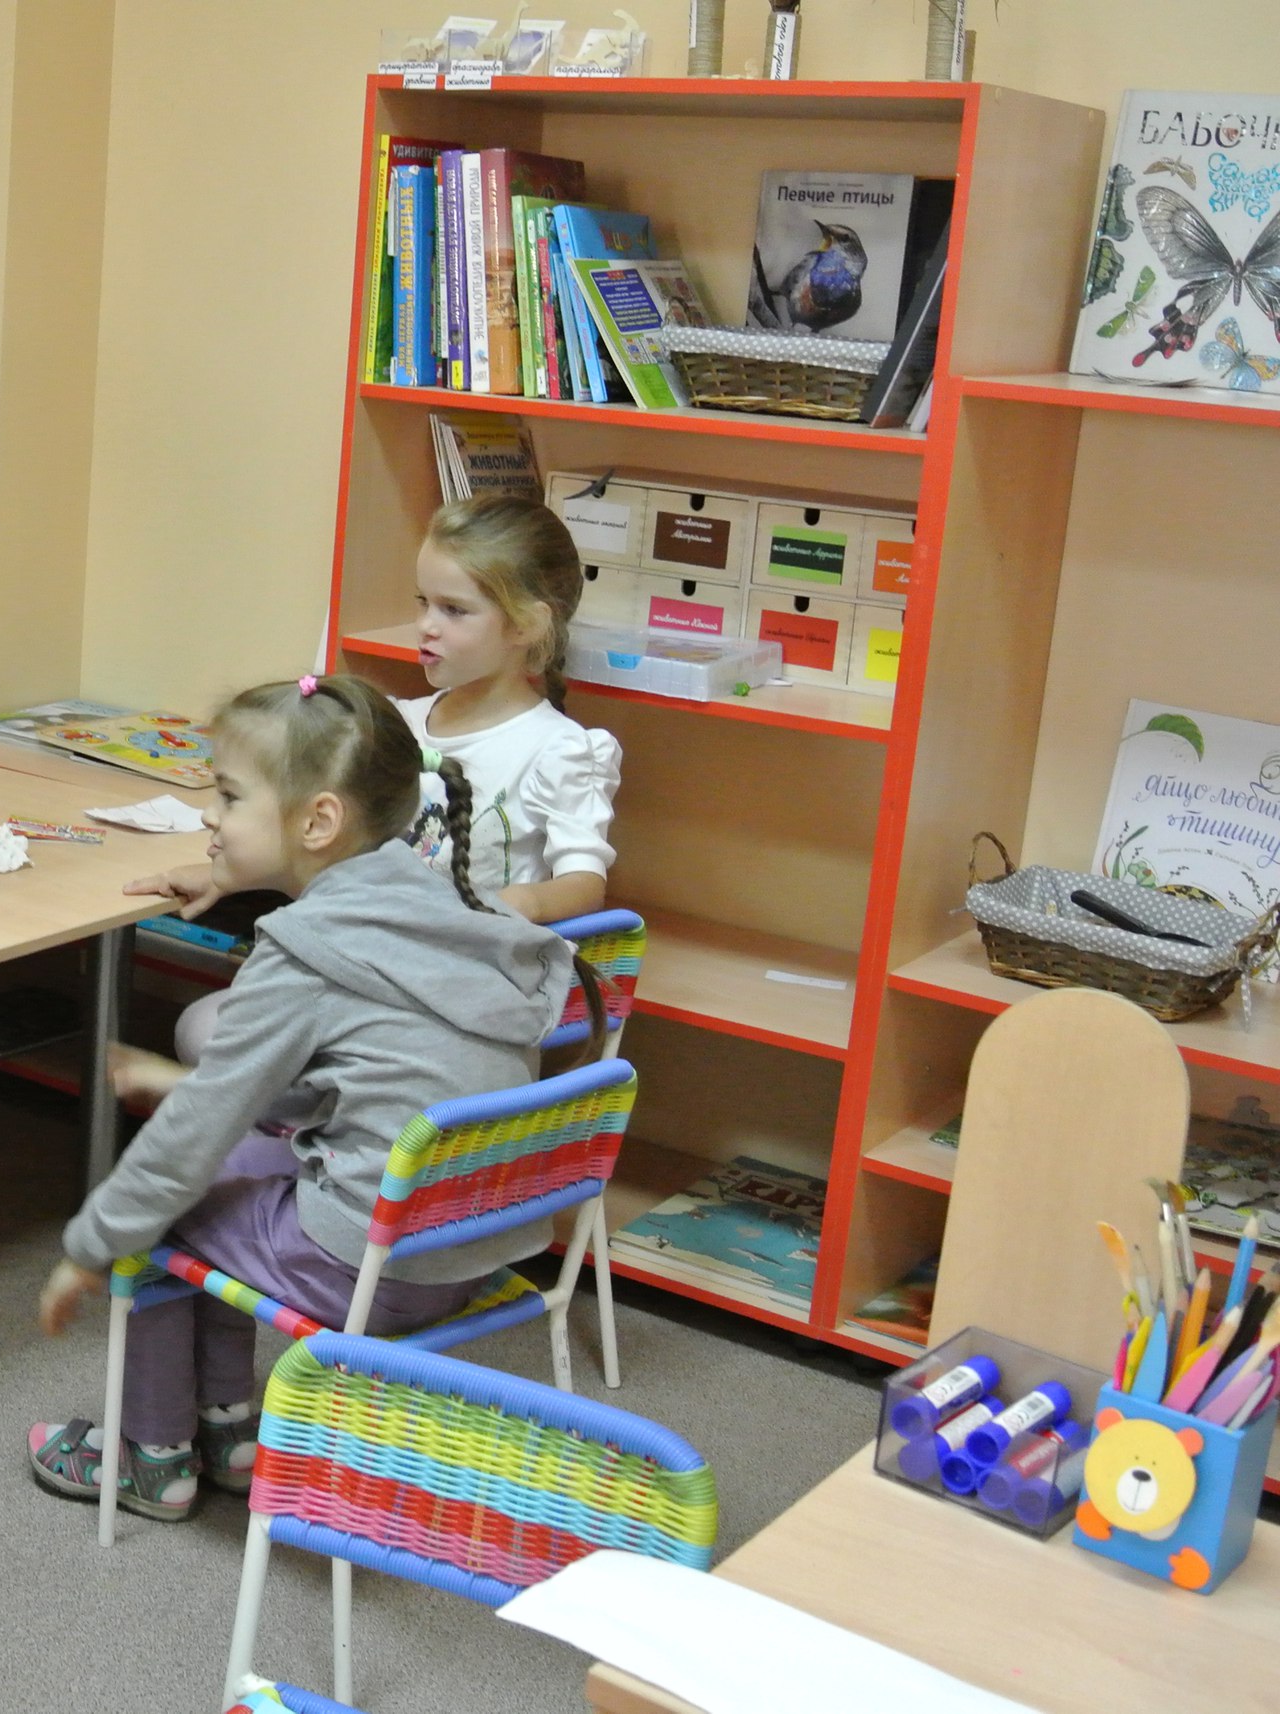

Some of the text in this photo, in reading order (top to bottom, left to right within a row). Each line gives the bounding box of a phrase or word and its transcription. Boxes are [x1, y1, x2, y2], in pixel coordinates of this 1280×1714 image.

[777, 186, 895, 208] Певчие птицы
[399, 186, 415, 290] ЖИВОТНЫХ
[469, 167, 485, 341] ЭНЦИКЛОПЕДИЯ ЖИВОЙ ПРИРОДЫ
[468, 454, 529, 470] ЖИВОТНЫЕ
